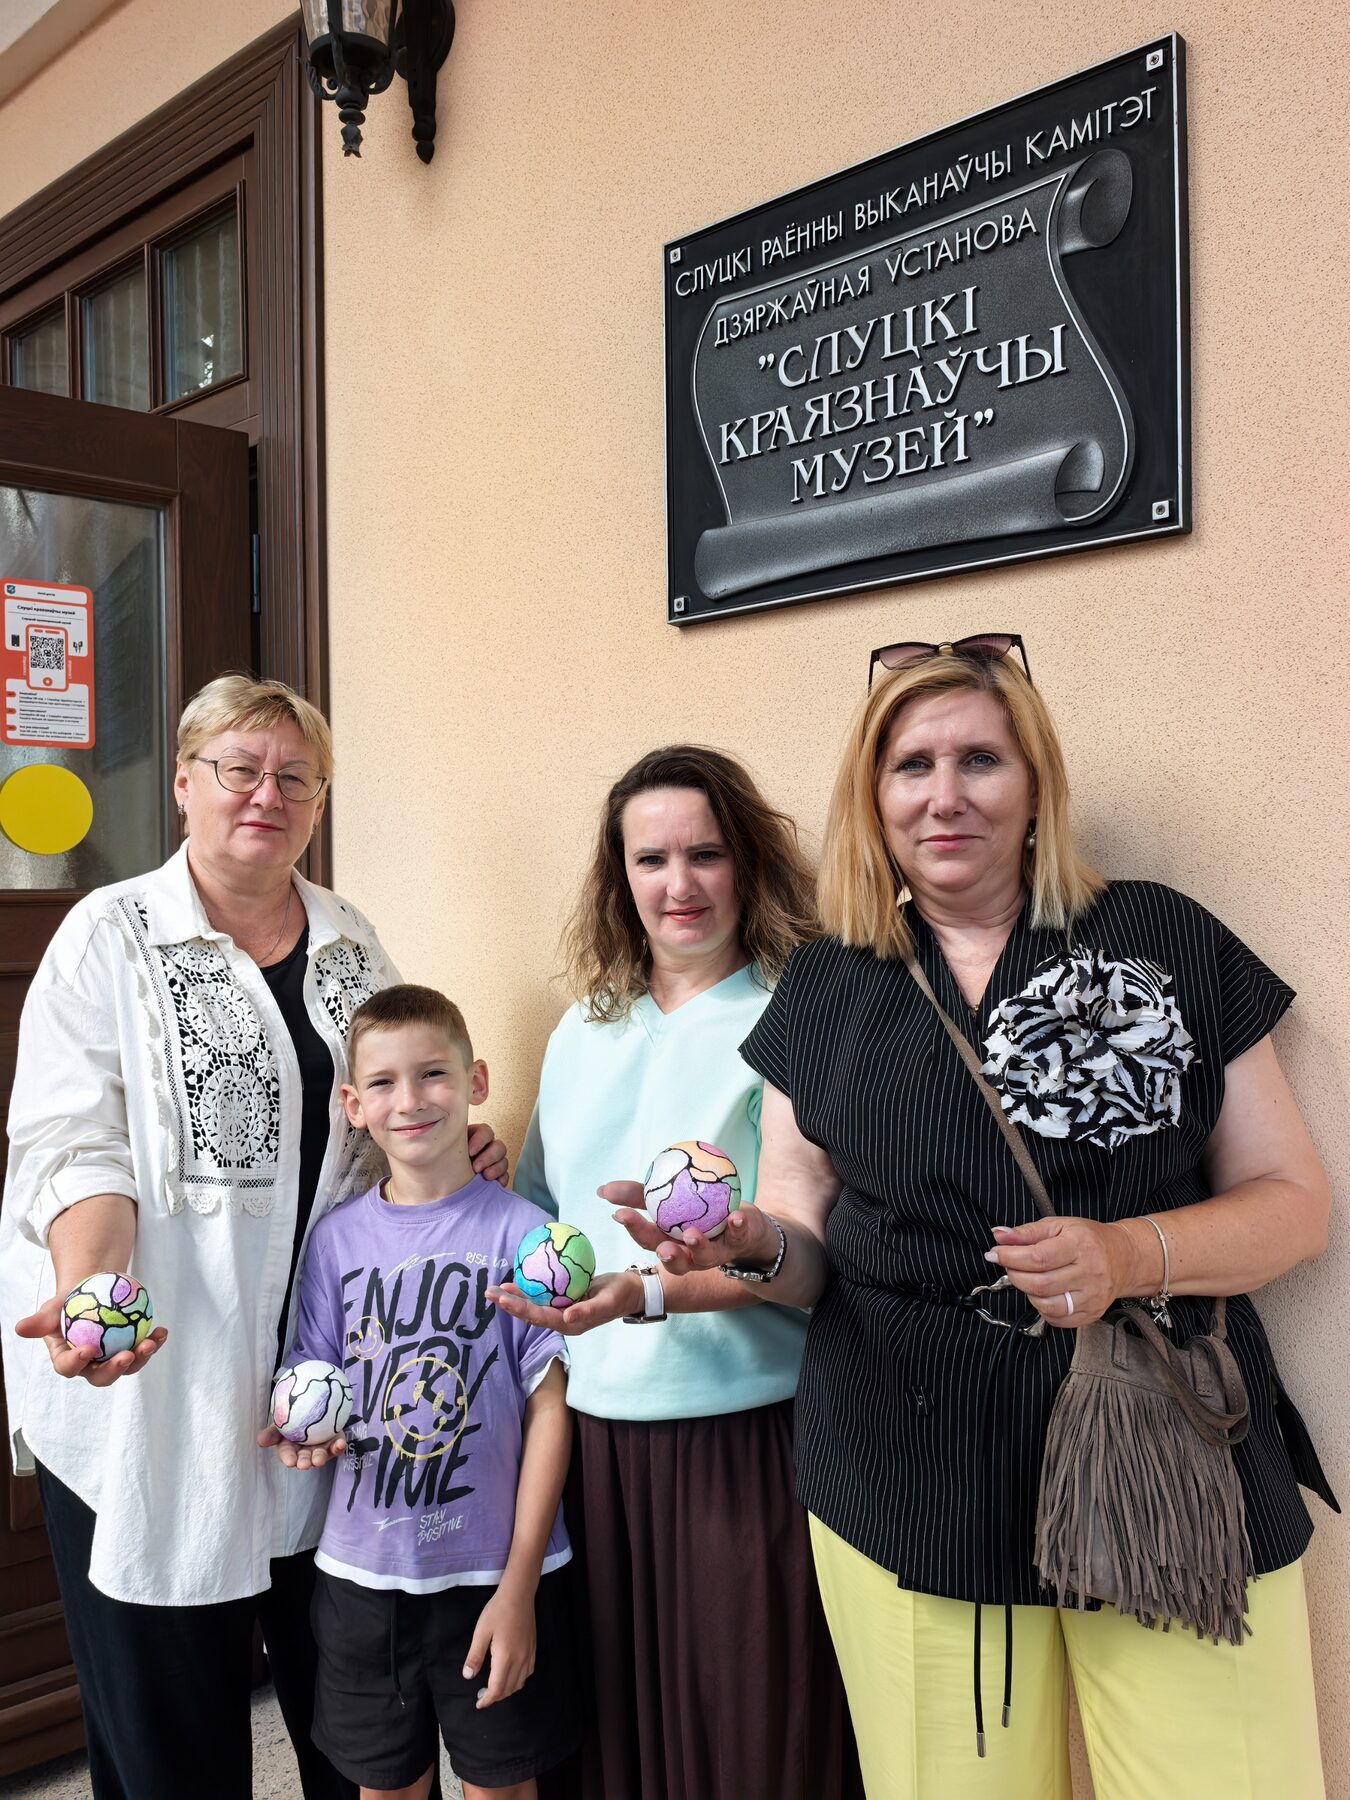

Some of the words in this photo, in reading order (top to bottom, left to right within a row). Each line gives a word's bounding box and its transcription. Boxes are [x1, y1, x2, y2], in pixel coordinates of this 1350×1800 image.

[675, 248, 753, 298] СЛУЦКІ
[760, 210, 844, 266] РАЁННЫ
[854, 144, 1013, 229] ВЫКАНАЎЧЫ
[1025, 87, 1157, 167] КАМІТЭТ
[715, 265, 870, 348] ДЗЯРЖАЎНАЯ
[718, 323, 1069, 465] КРАЯЗНАЎЧЫ
[465, 1251, 489, 1266] RISE
[341, 1259, 514, 1345] ENJOY
[345, 1423, 482, 1512] TIME
[417, 1515, 464, 1546] POSITIVE
[419, 1508, 447, 1529] STAY
